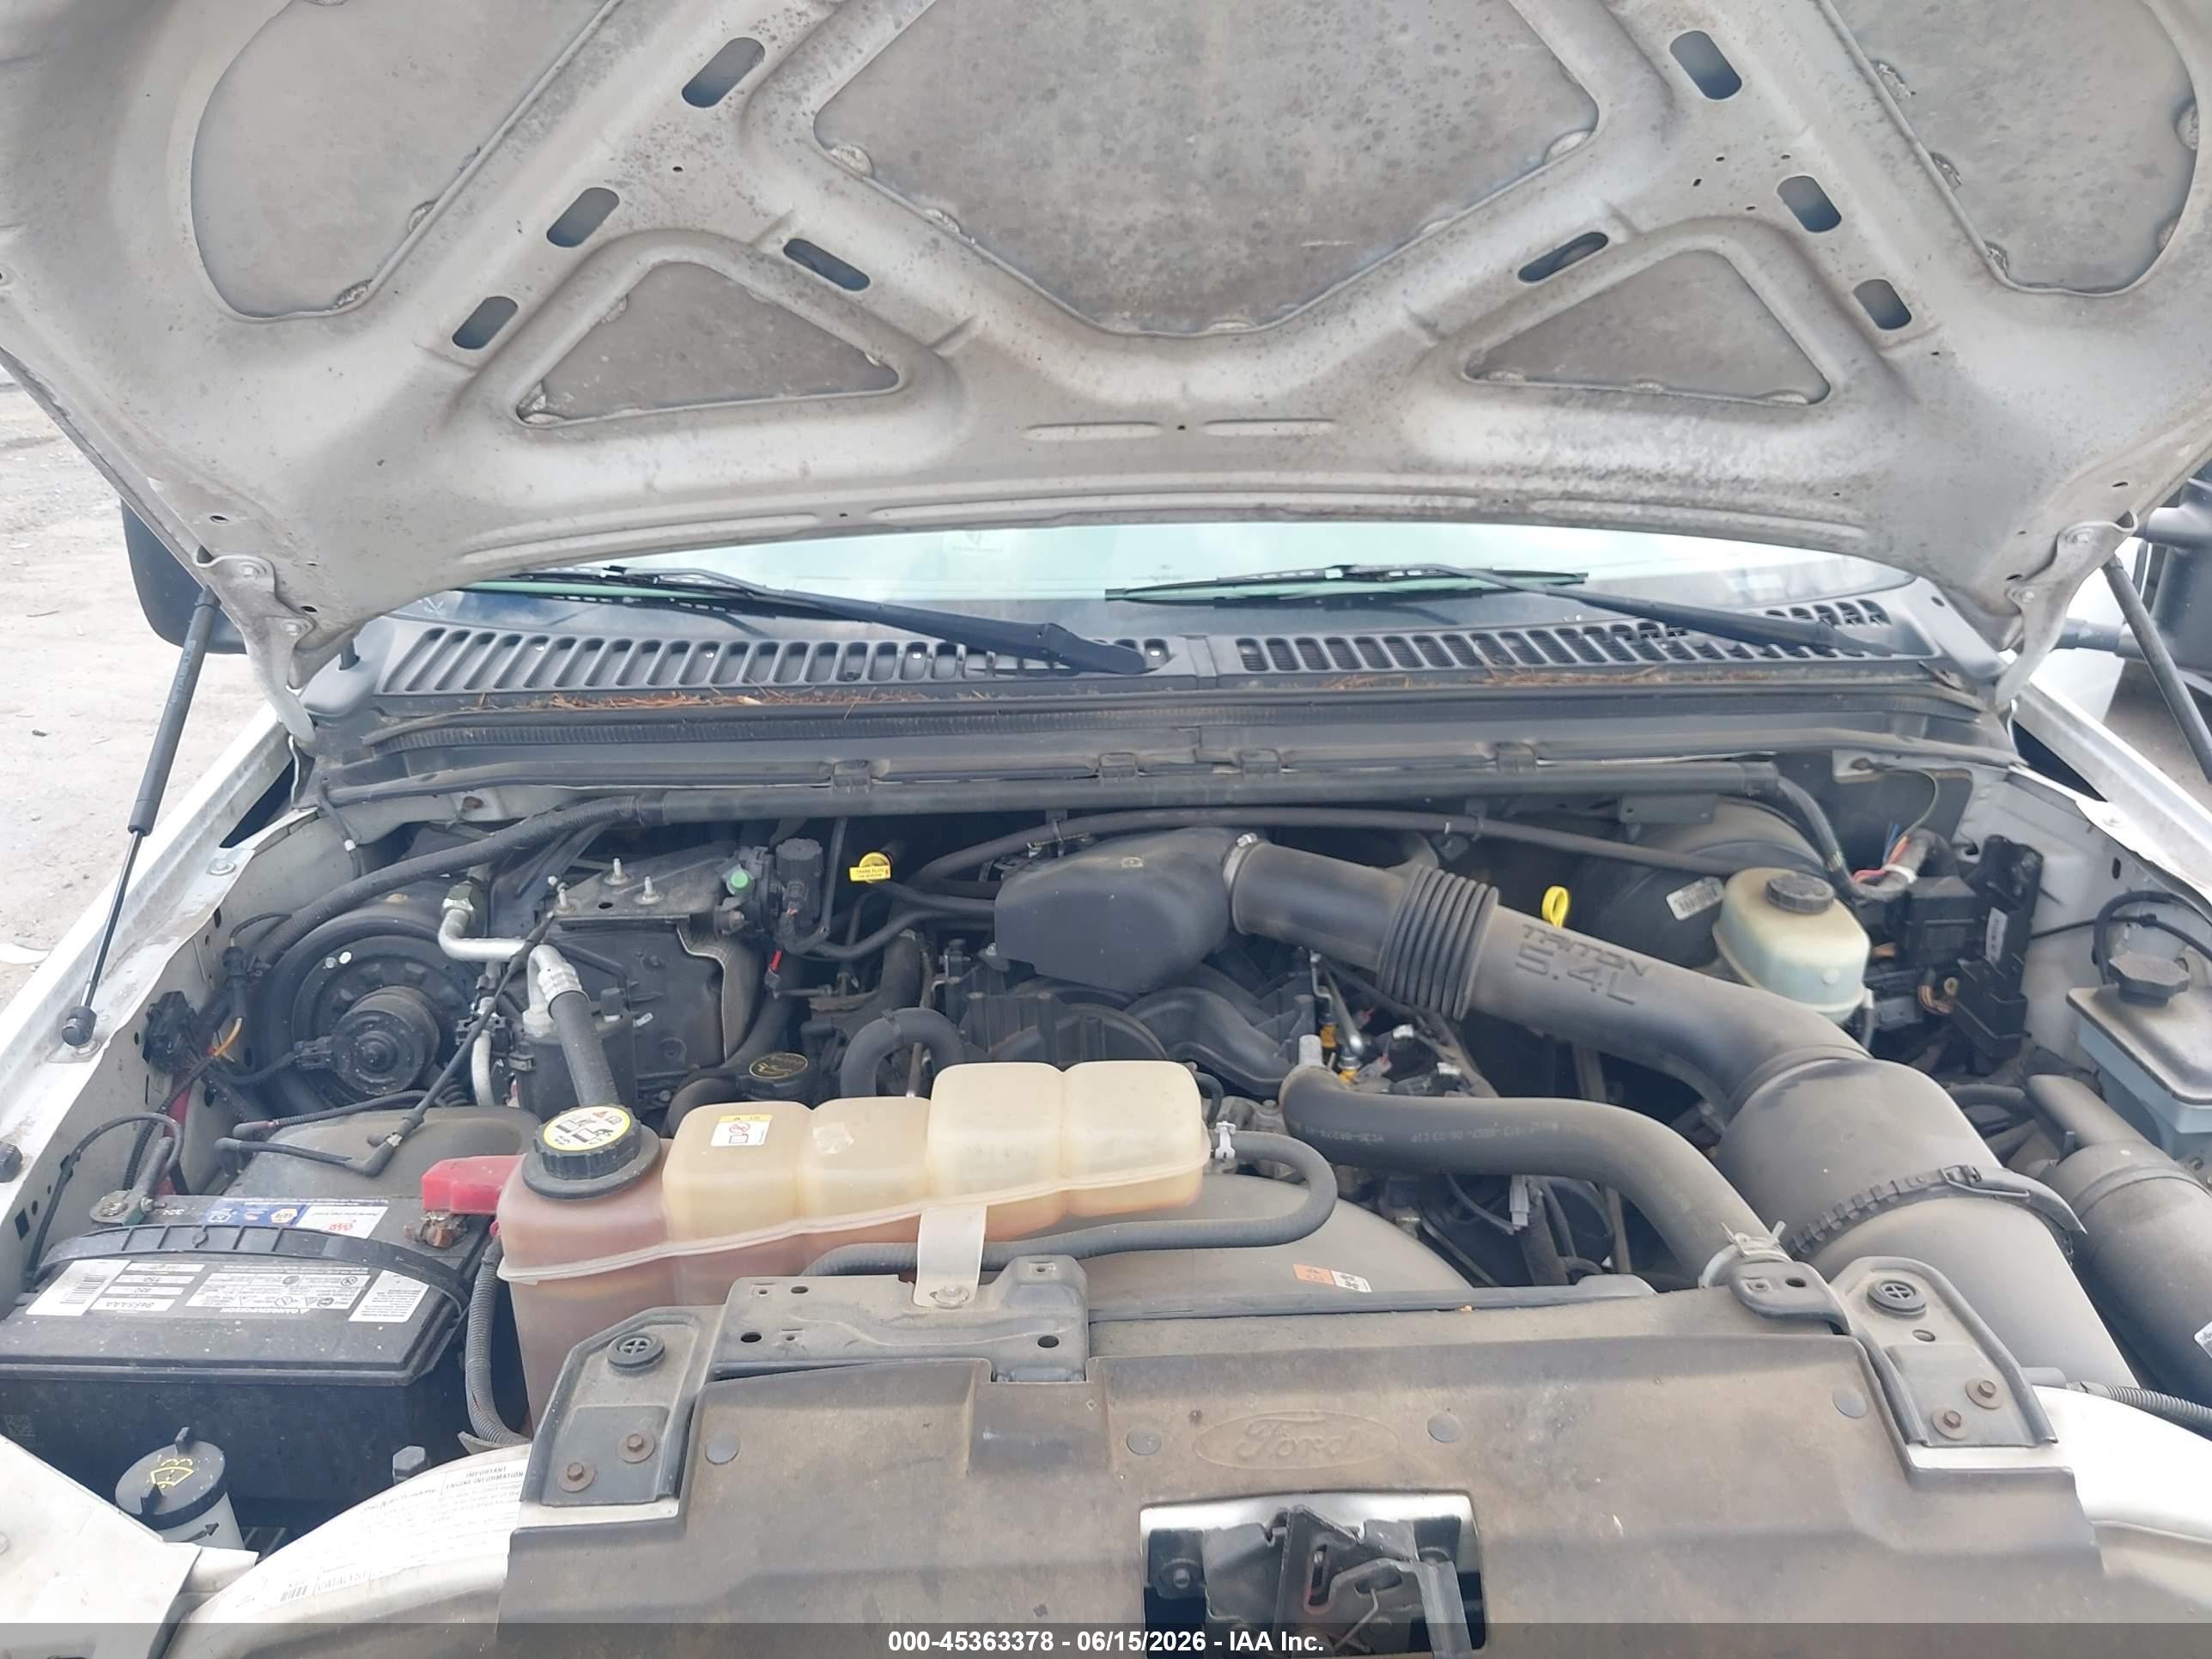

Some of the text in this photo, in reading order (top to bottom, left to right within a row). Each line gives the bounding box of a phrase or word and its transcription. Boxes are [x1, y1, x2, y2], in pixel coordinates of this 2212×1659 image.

[1522, 924, 1650, 977] TRITON
[1516, 944, 1635, 1006] 5.4L
[1235, 1417, 1360, 1462] Ford
[465, 1466, 507, 1478] IMPORTANT
[473, 1471, 525, 1485] INFORMATION
